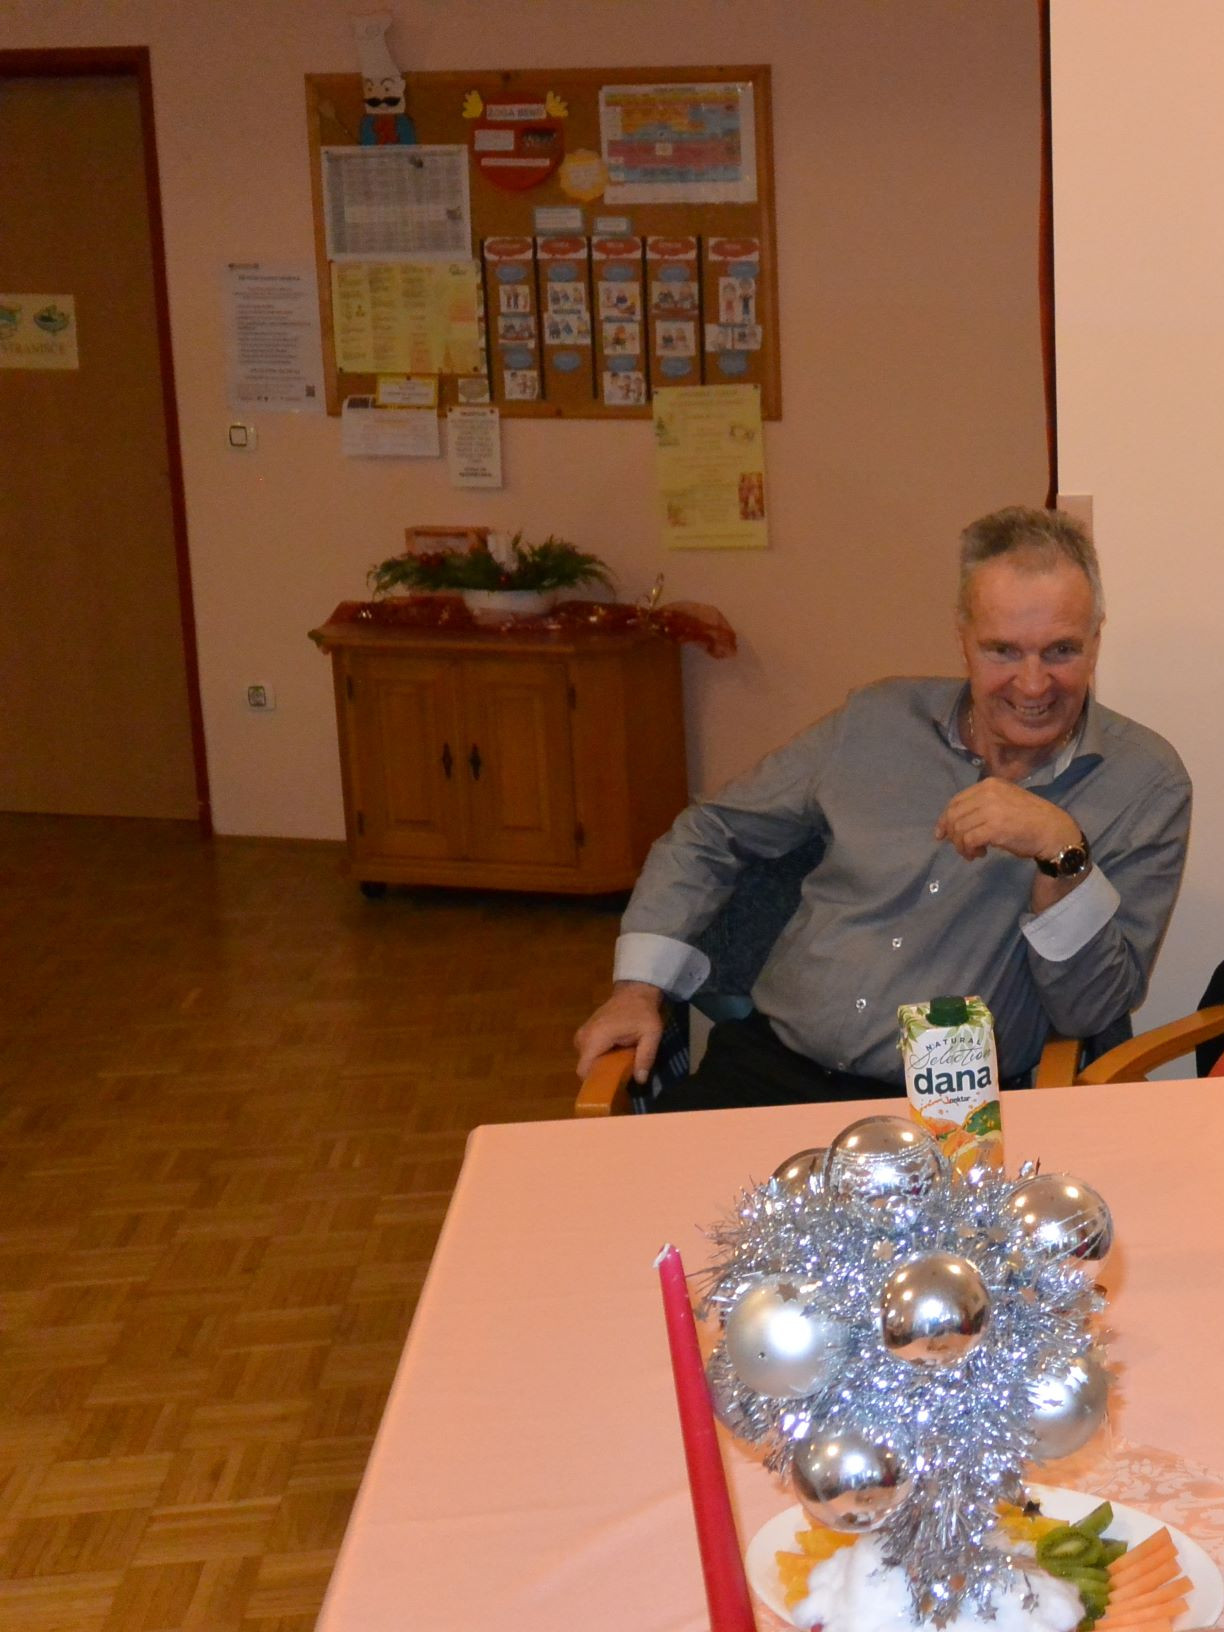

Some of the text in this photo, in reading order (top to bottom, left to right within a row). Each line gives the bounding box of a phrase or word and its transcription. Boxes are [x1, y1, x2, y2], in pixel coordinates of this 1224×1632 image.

[925, 1037, 982, 1052] NATURAL
[907, 1046, 991, 1071] Selection
[913, 1066, 992, 1095] dana
